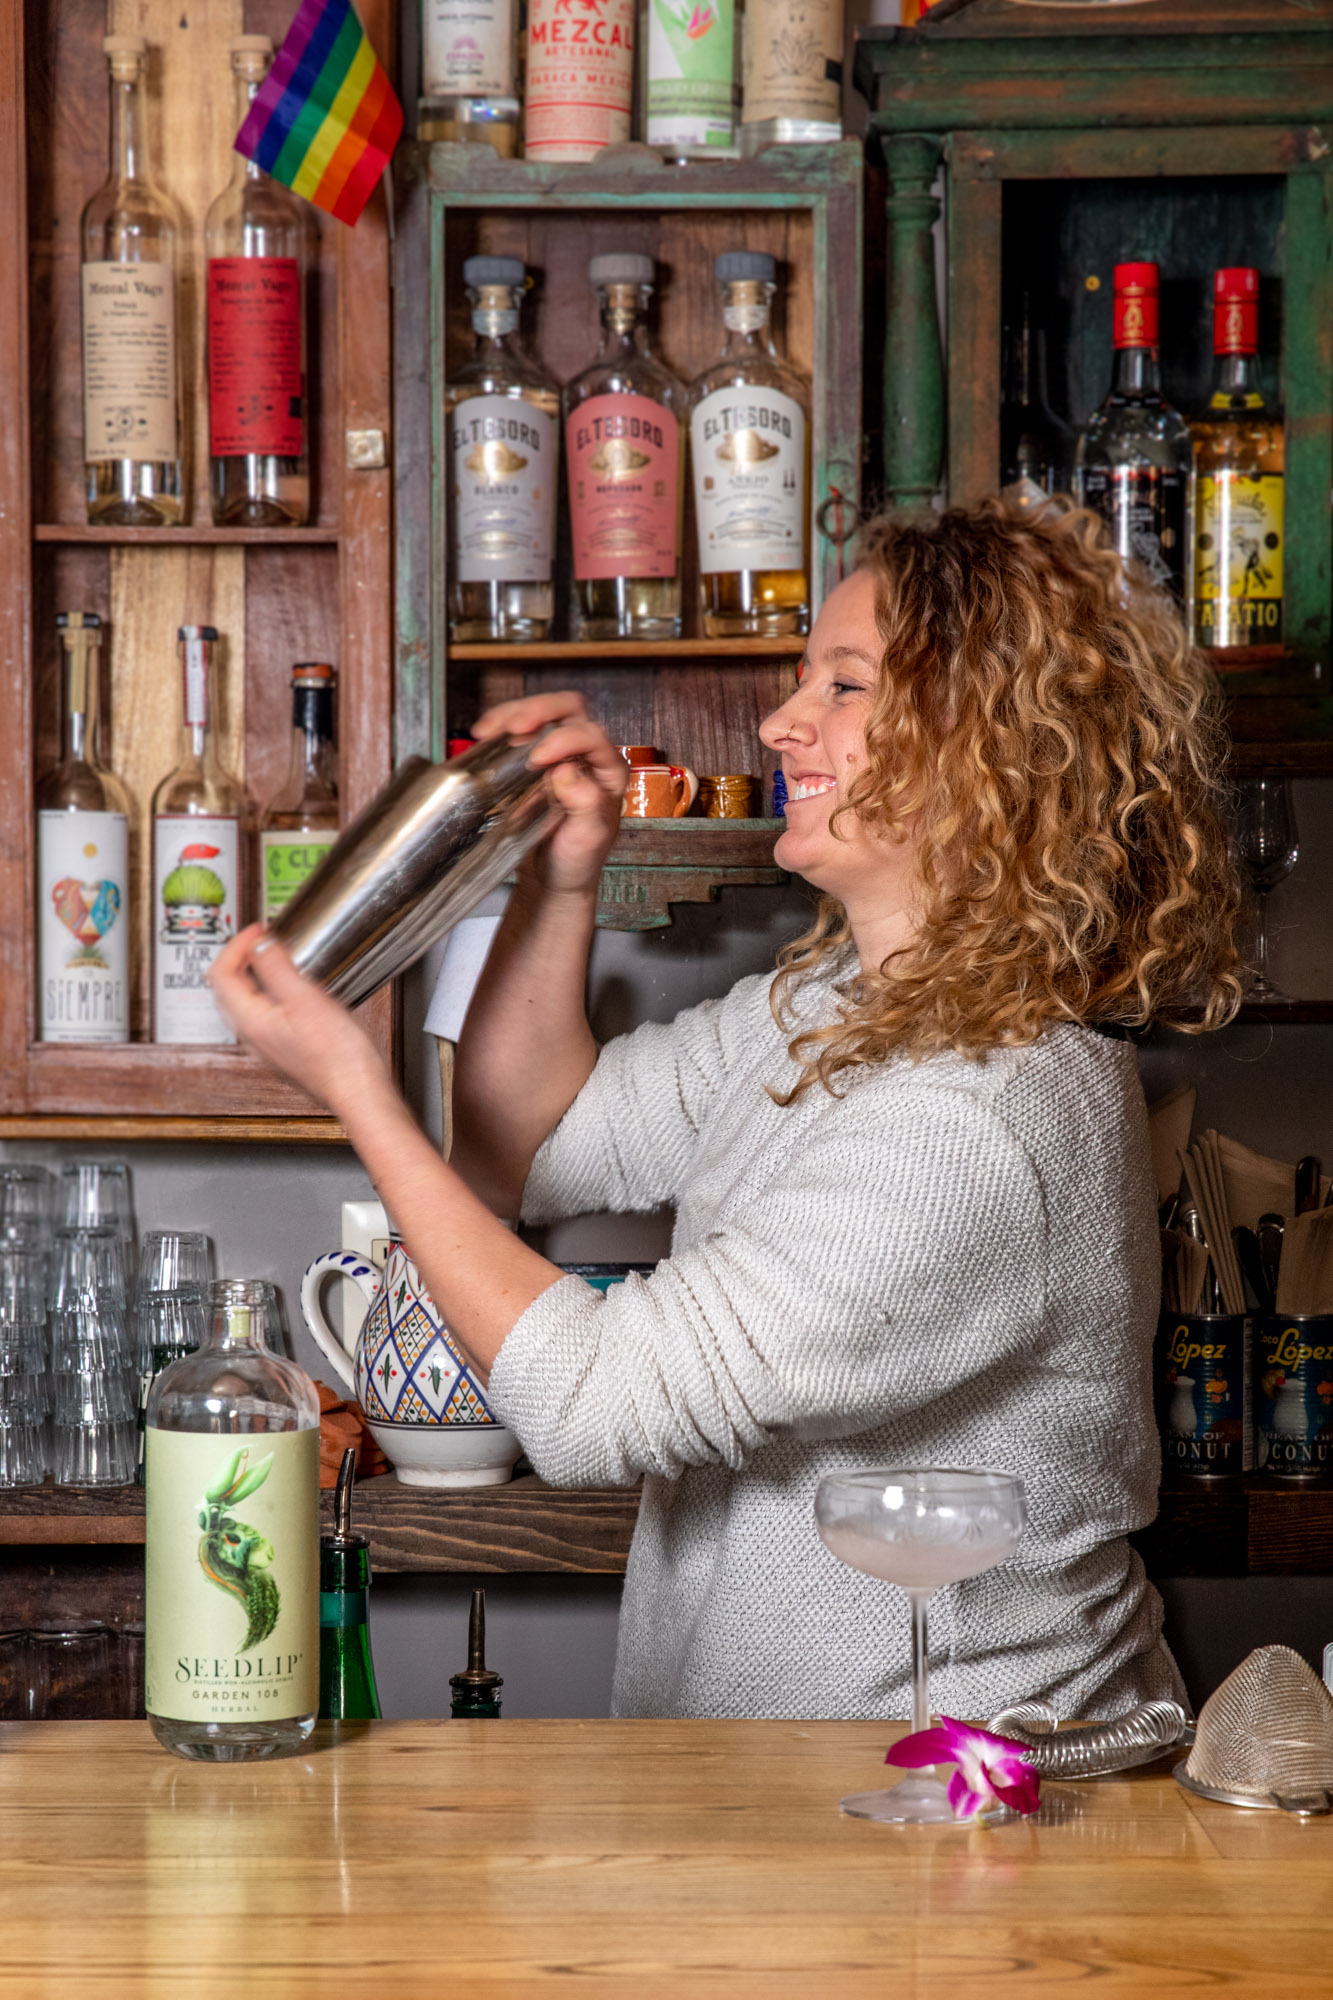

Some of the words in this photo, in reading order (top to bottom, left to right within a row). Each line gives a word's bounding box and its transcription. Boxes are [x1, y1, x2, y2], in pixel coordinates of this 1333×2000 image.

[531, 19, 633, 51] MEZCAL
[545, 46, 617, 60] ARTESANAL
[89, 281, 129, 295] Mezcal
[133, 281, 164, 298] Vago
[703, 418, 720, 441] EL
[719, 405, 793, 440] TESORO
[454, 428, 469, 450] EL
[468, 416, 541, 452] TESORO
[576, 427, 592, 451] EL
[591, 415, 664, 450] TESORO
[473, 484, 520, 496] BLANCO
[1196, 602, 1279, 628] AATIO
[174, 946, 213, 962] FLOR
[1165, 1324, 1228, 1370] López
[1202, 1431, 1225, 1441] OF
[1271, 1442, 1333, 1461] CONU
[175, 1654, 299, 1684] SEEDLIP
[192, 1690, 250, 1700] GARDEN
[257, 1689, 280, 1699] 108
[211, 1705, 260, 1713] HERBAL
